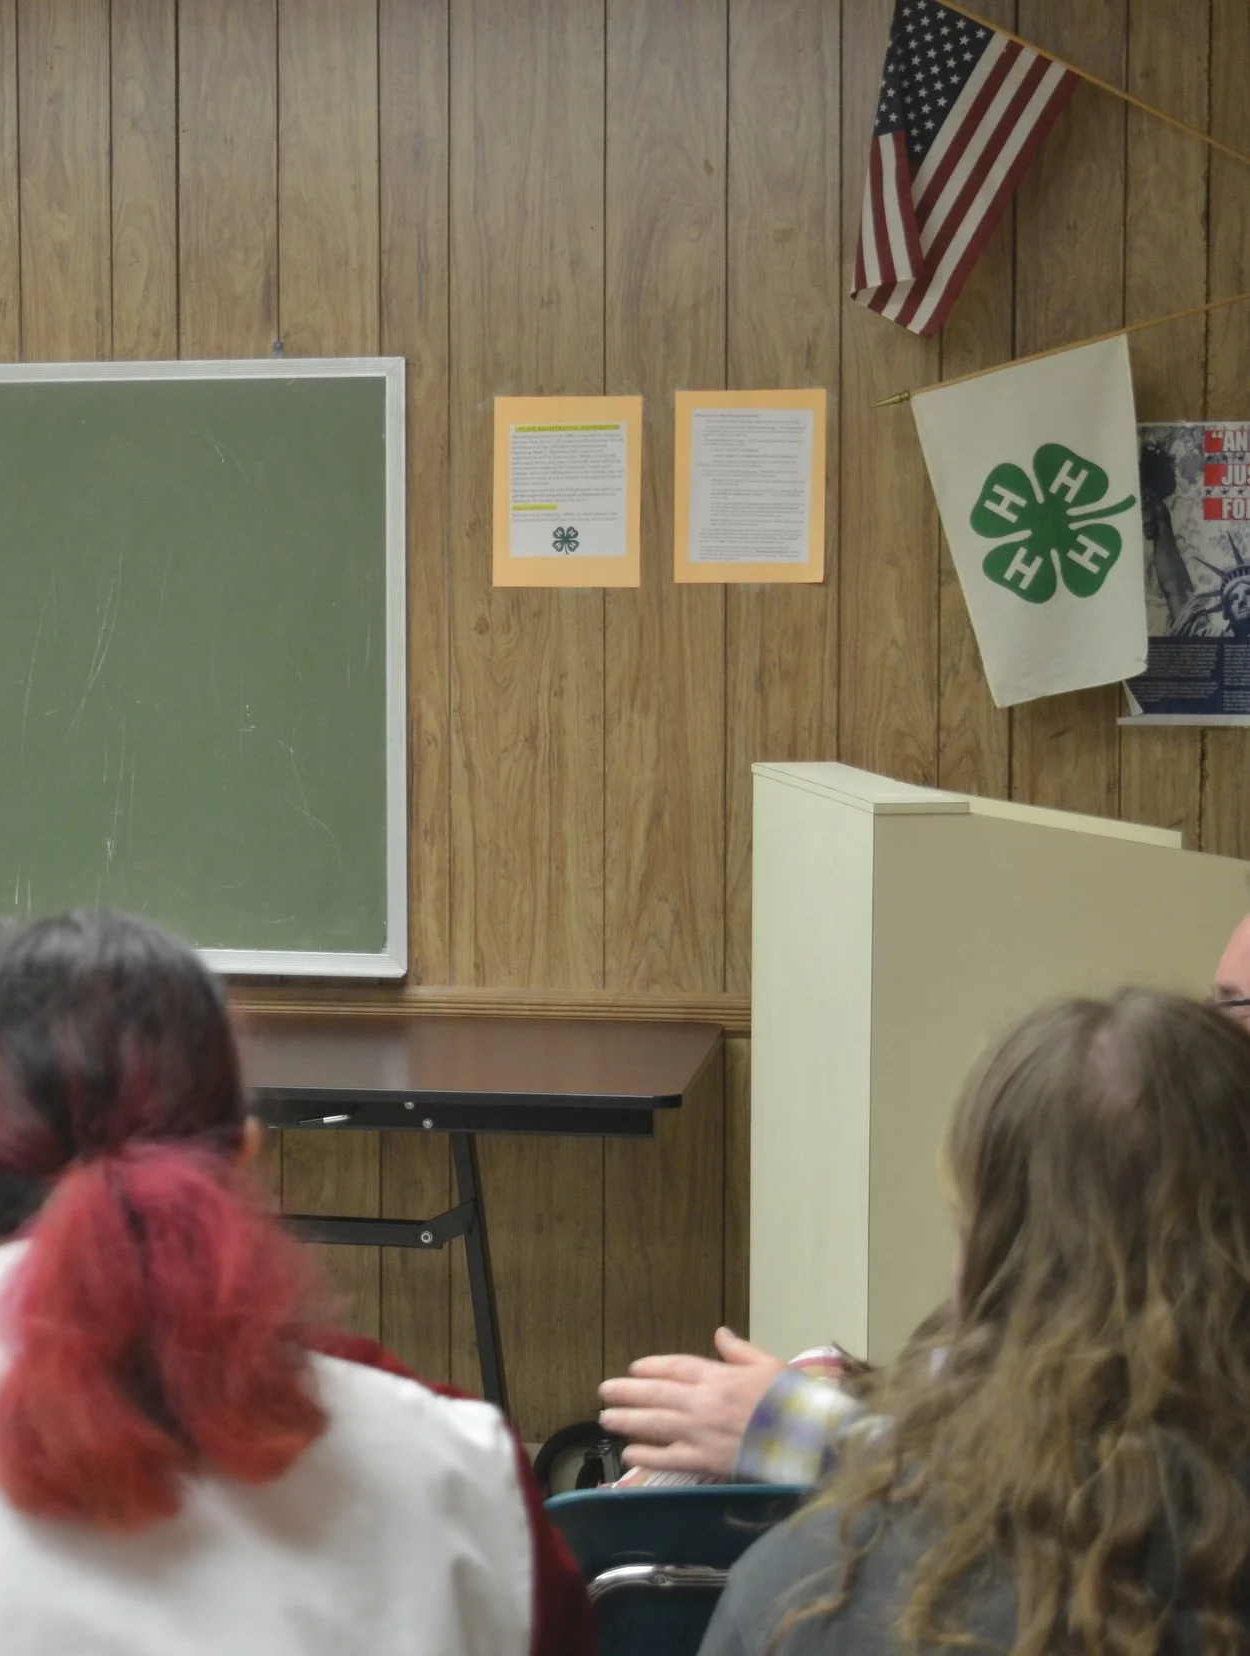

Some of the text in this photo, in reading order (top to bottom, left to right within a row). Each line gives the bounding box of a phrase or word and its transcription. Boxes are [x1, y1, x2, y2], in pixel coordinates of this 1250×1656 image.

[1211, 430, 1250, 451] “AN
[1049, 459, 1089, 503] H
[983, 484, 1028, 523] H
[1222, 498, 1250, 520] FO
[1003, 547, 1044, 590] H
[1067, 534, 1110, 574] H
